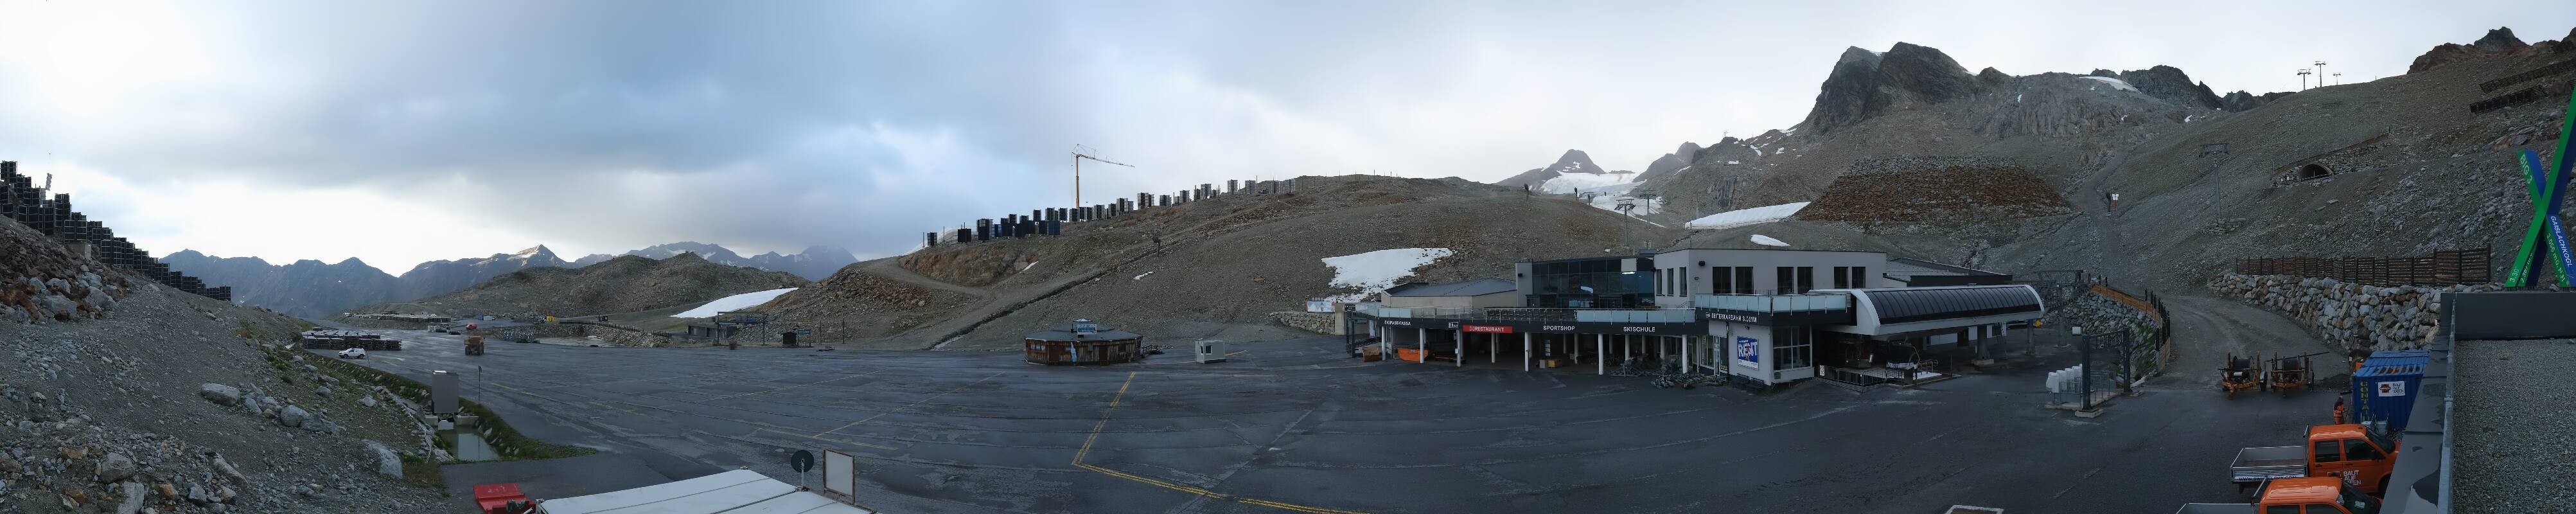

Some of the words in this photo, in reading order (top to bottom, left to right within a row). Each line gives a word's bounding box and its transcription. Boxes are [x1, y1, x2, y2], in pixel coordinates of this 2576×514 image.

[2519, 154, 2530, 175] BIG
[2527, 175, 2533, 184] 3
[2551, 216, 2573, 267] GAISLACHKOGL
[1738, 342, 1758, 357] RENT
